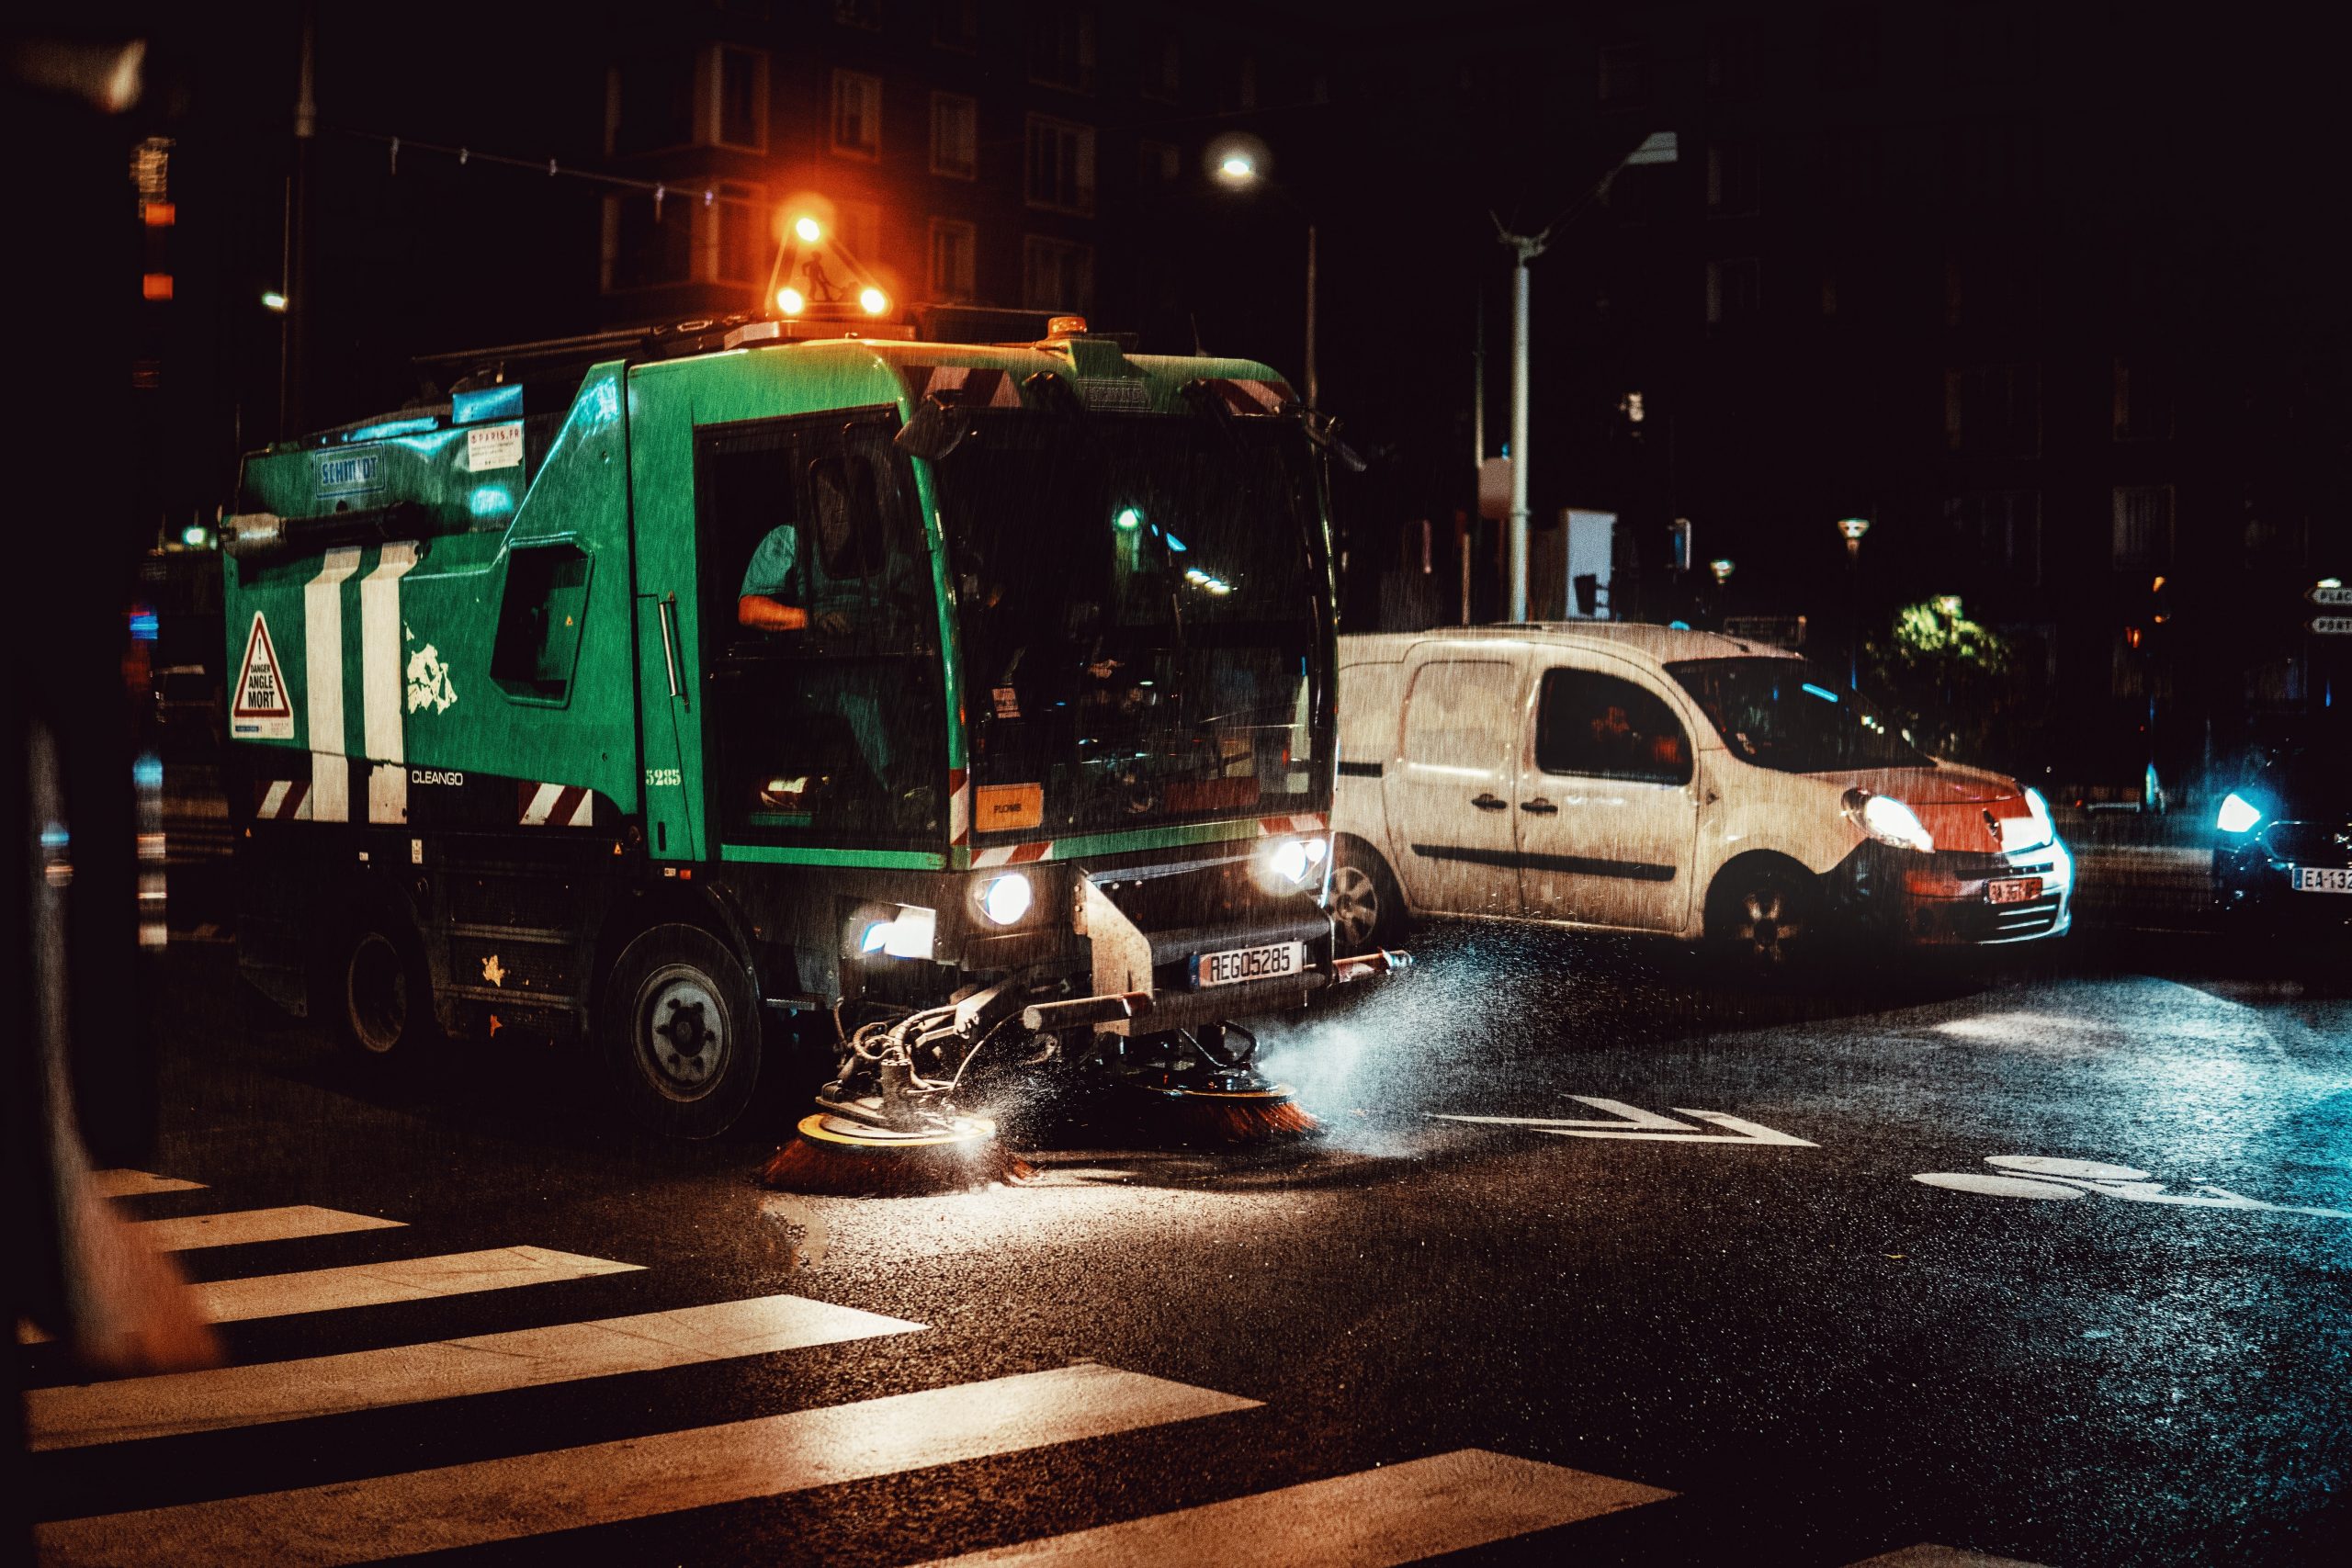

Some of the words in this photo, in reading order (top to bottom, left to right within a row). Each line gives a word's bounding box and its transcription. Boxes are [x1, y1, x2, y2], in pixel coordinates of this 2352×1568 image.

[479, 428, 519, 441] PARIS.FR
[250, 663, 271, 673] DANGER
[248, 674, 273, 689] ANGLE
[248, 691, 275, 708] MORT
[412, 770, 464, 786] CLEANGO
[645, 768, 682, 786] 5285
